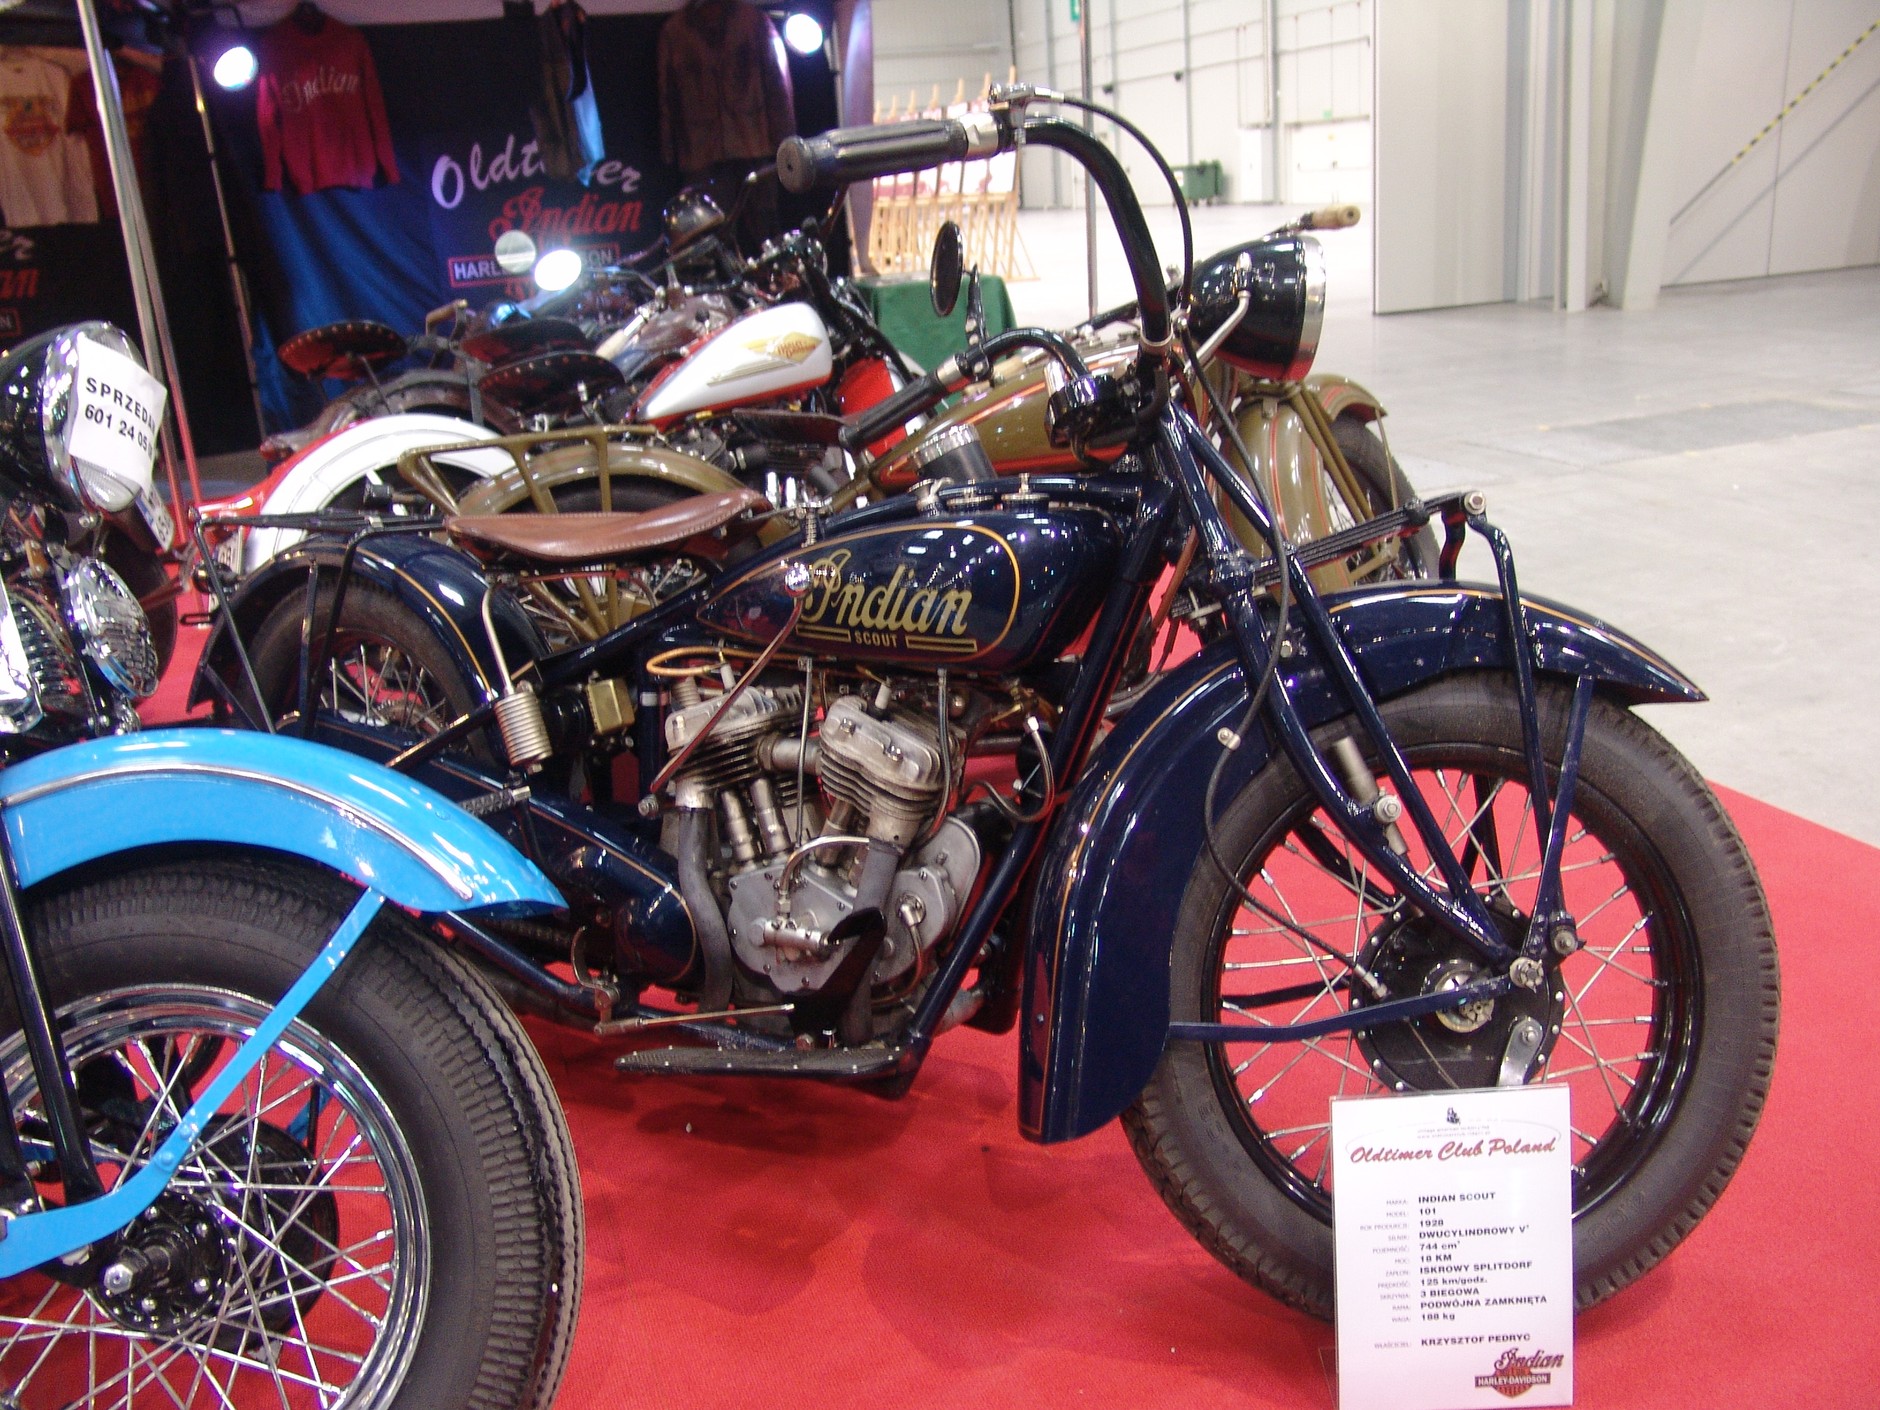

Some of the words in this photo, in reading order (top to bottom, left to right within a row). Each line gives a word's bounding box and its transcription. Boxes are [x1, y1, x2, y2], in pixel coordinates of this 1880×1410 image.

[431, 133, 642, 210] Oldter
[488, 186, 644, 243] Indian
[84, 403, 112, 429] 601
[118, 420, 135, 441] 24
[794, 548, 973, 635] Indian
[854, 631, 898, 648] SCOUT
[1350, 1146, 1434, 1164] Oldtimer
[1438, 1139, 1485, 1162] Club
[1488, 1137, 1557, 1157] Poland
[1418, 1194, 1456, 1205] INDIAN
[1459, 1191, 1497, 1202] SCOUT
[1420, 1207, 1437, 1216] 101
[1420, 1218, 1445, 1228] 1928
[1419, 1226, 1516, 1240] DWUCYLINDROWY
[1419, 1242, 1438, 1252] 744
[1421, 1254, 1433, 1264] 18
[1435, 1253, 1453, 1263] KM
[1419, 1264, 1470, 1275] ISKROWY
[1473, 1261, 1533, 1272] SPLITDORF
[1421, 1278, 1439, 1287] 125
[1441, 1275, 1488, 1287] km/godz.
[1420, 1290, 1427, 1299] 3
[1429, 1287, 1481, 1298] BIEGOWA
[1420, 1298, 1482, 1310] PODWÓJNA
[1484, 1295, 1548, 1307] ZAMKNIĘTA
[1442, 1312, 1456, 1322] kg
[1420, 1335, 1486, 1347] KRZYSZTOF
[1487, 1332, 1532, 1344] PEDRYC
[1493, 1347, 1565, 1371] Indian
